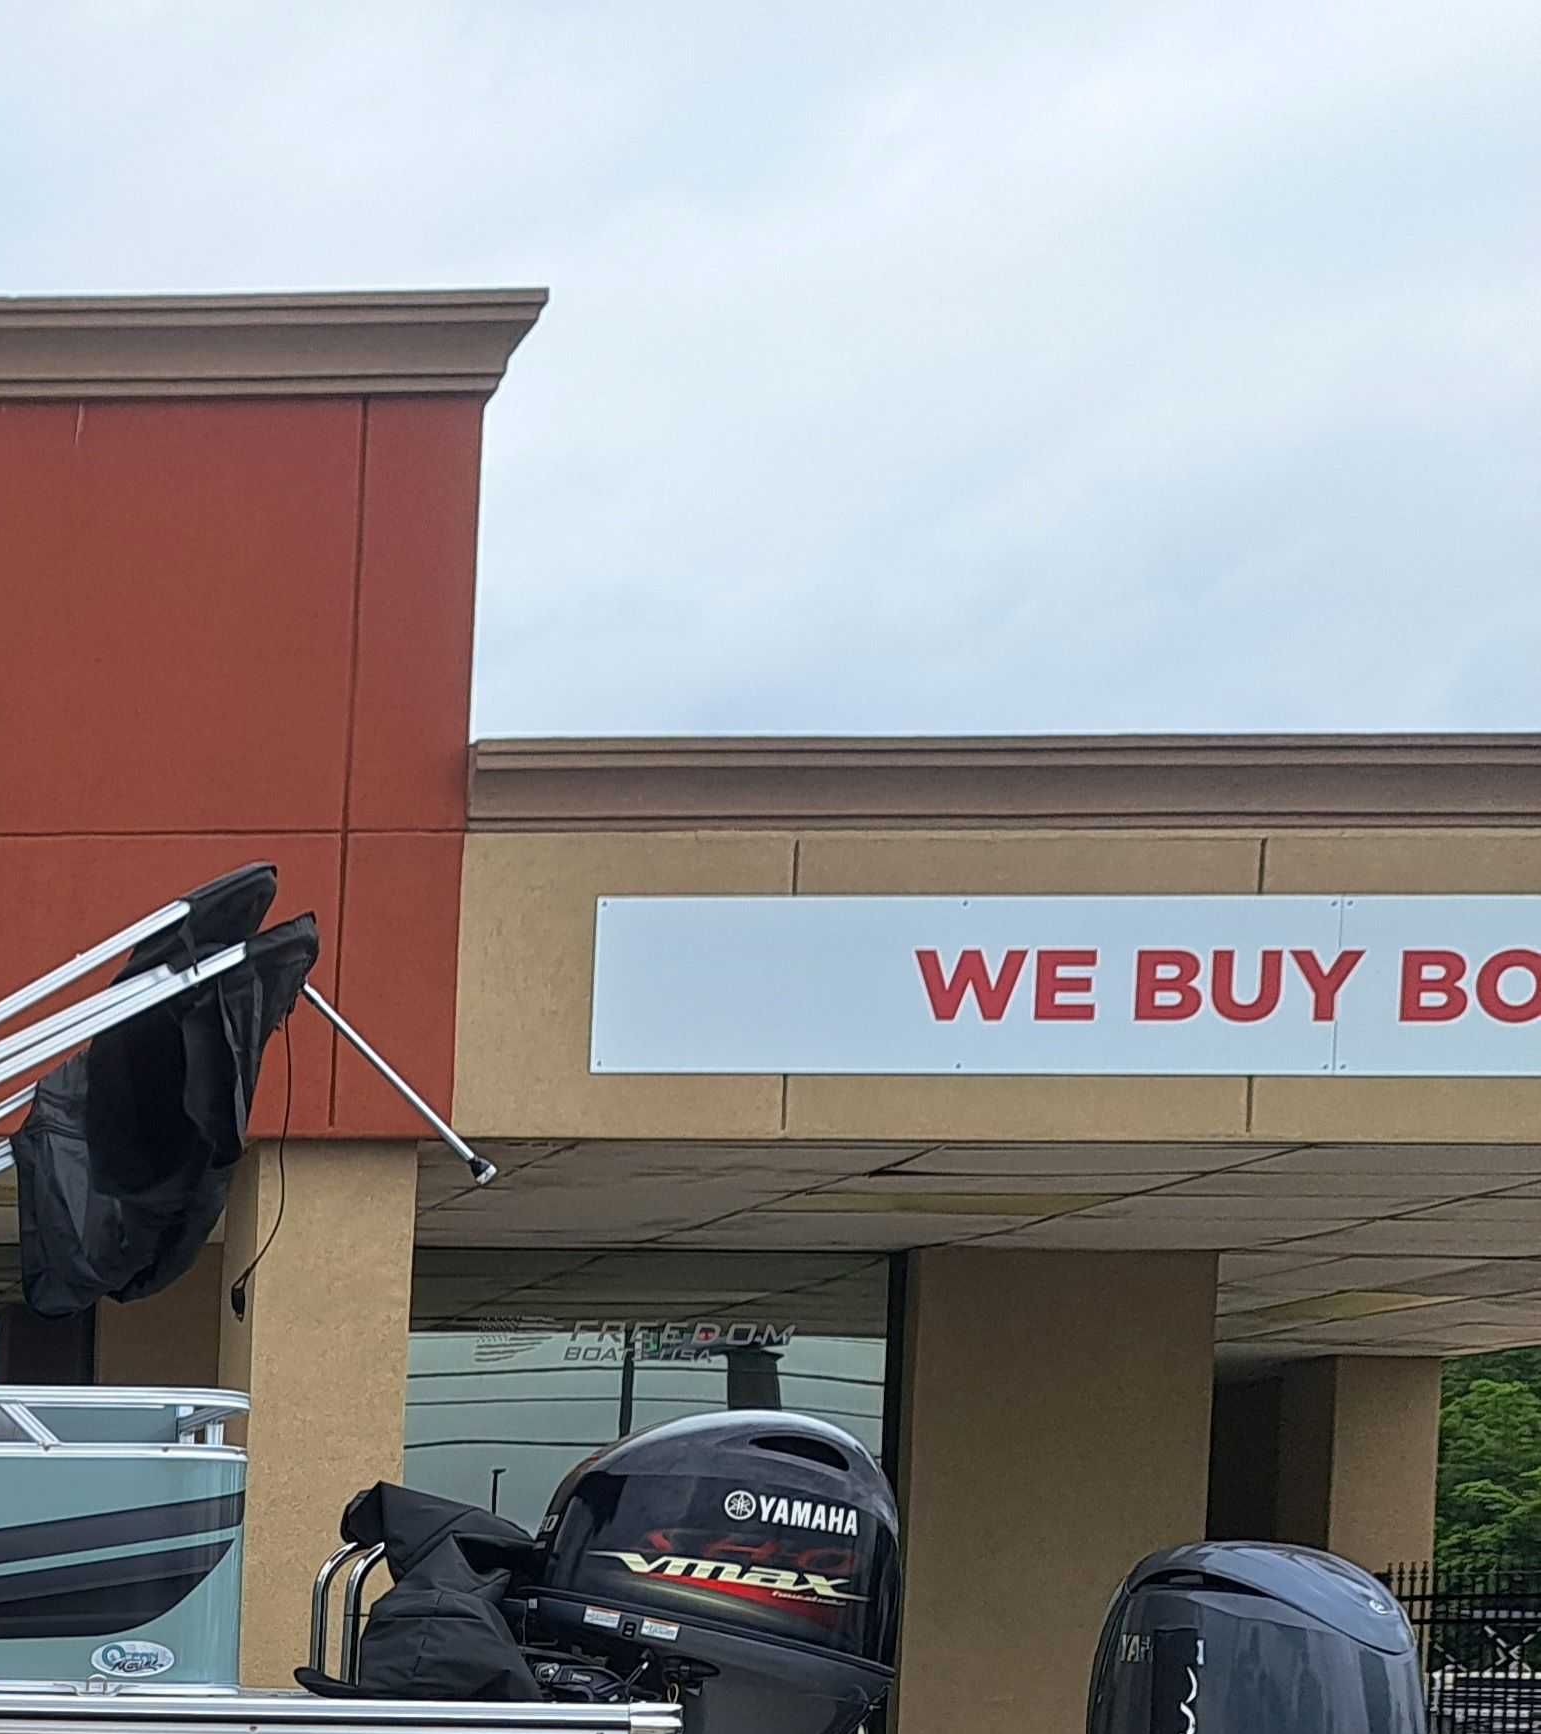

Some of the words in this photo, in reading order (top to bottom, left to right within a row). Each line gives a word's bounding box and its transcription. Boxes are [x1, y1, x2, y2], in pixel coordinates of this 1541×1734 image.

[915, 948, 1098, 1021] WE
[1133, 948, 1367, 1022] BUY
[570, 1319, 796, 1346] FREEDOM
[759, 1495, 859, 1537] YAMAHA
